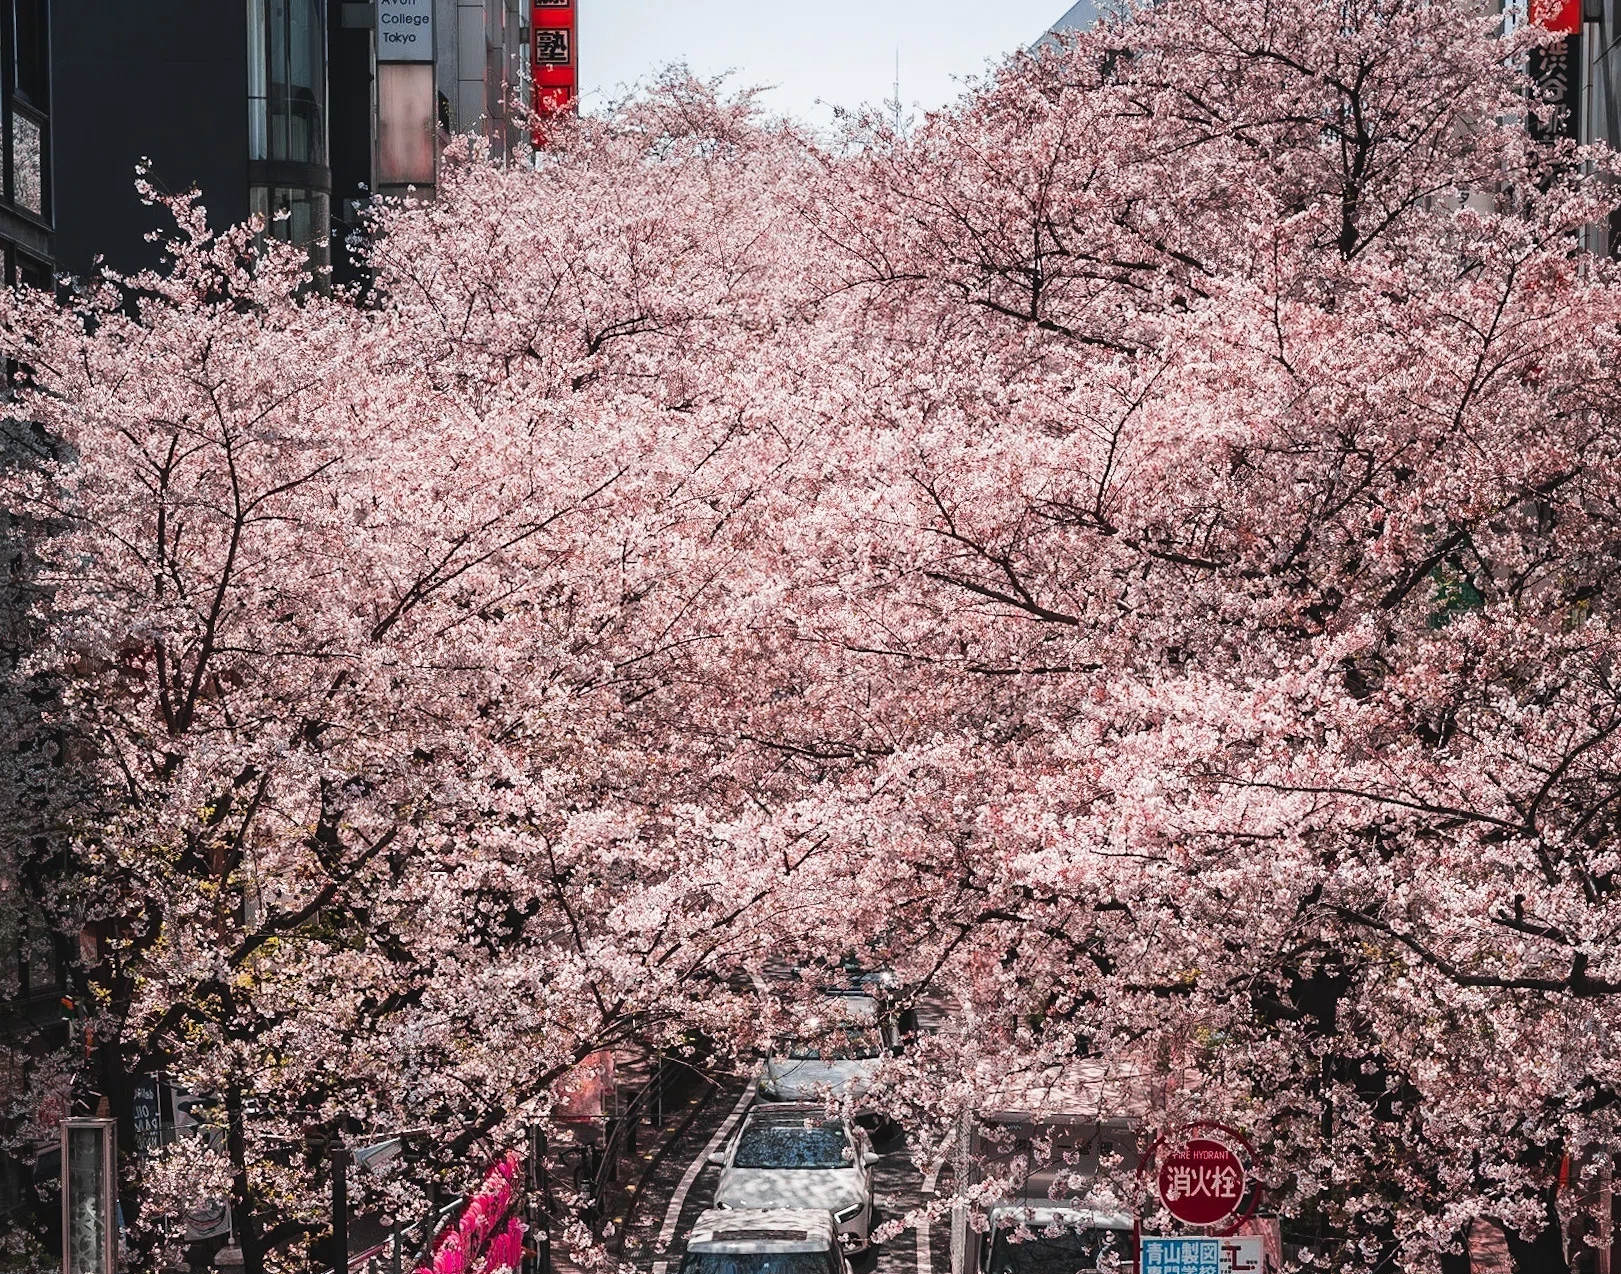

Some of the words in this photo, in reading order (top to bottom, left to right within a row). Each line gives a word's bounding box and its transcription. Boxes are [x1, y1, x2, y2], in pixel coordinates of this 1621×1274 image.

[381, 13, 430, 26] College
[383, 32, 417, 44] Tokyo
[1194, 1151, 1229, 1159] HYDRANT
[1167, 1166, 1237, 1198] 消火栓
[1146, 1242, 1217, 1265] 青山製図
